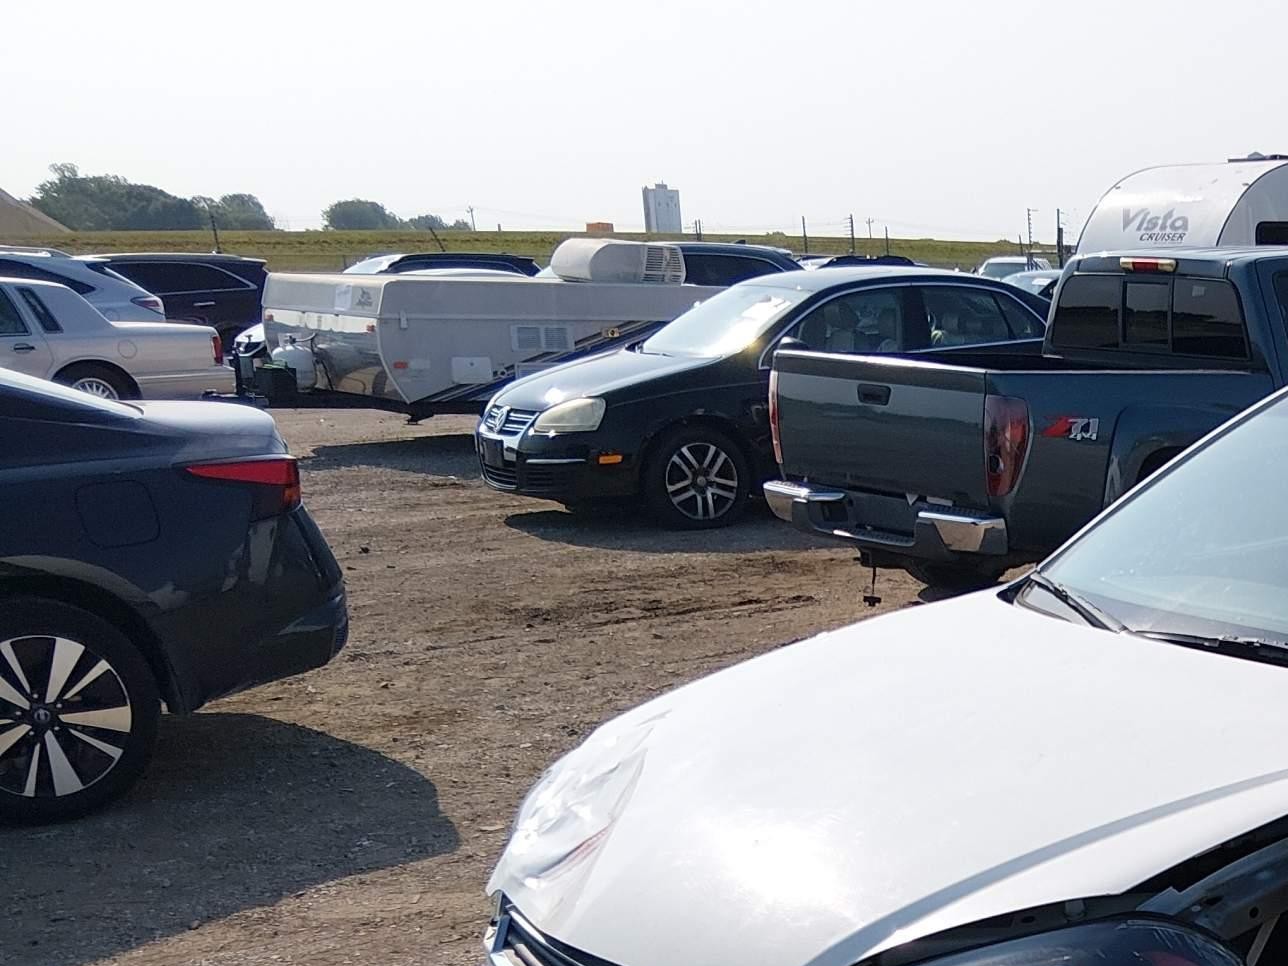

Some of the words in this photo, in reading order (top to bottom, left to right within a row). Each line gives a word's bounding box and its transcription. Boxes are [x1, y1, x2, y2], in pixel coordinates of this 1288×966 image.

[1122, 207, 1189, 232] Vista
[1139, 232, 1187, 241] CRUISER
[1042, 416, 1099, 437] Z71
